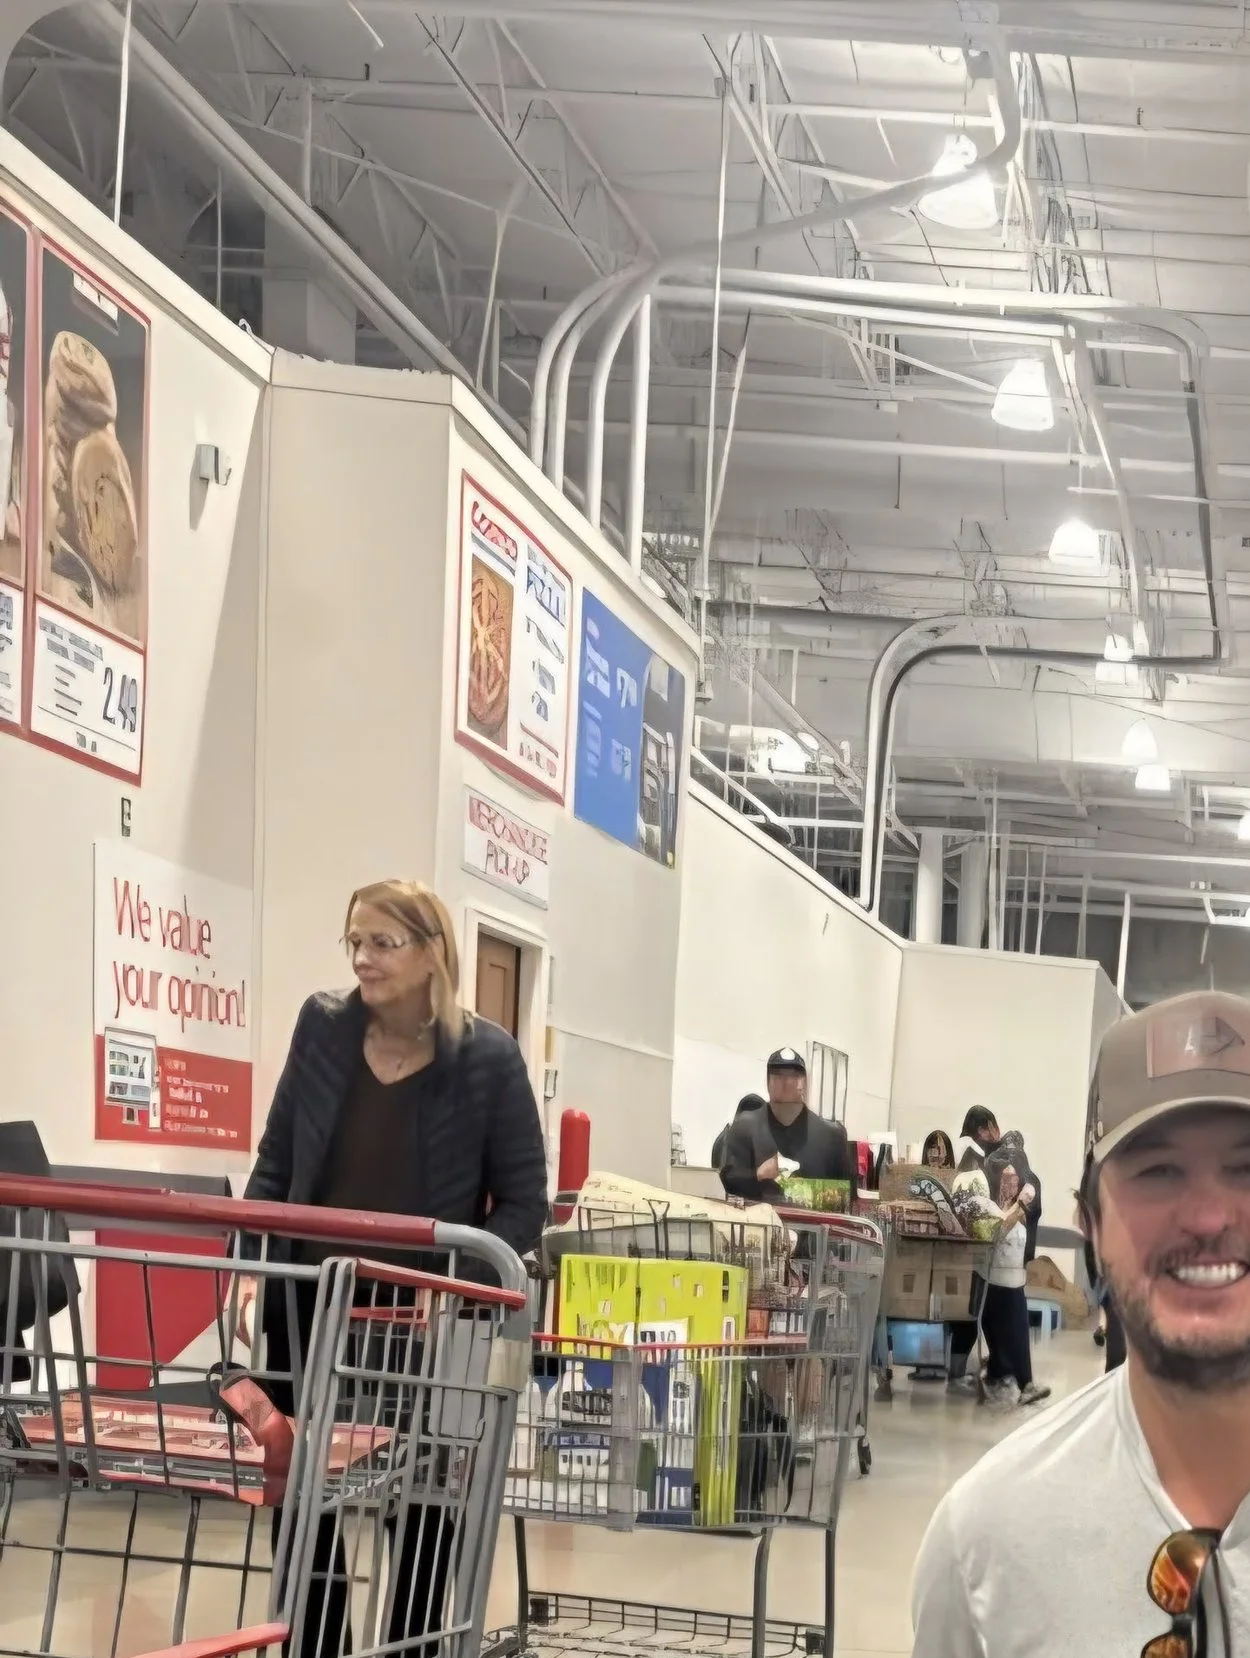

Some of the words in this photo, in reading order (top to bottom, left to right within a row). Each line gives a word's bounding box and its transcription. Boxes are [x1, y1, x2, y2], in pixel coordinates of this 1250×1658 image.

[113, 876, 152, 943] We
[158, 894, 212, 960] value
[112, 960, 163, 1020] your
